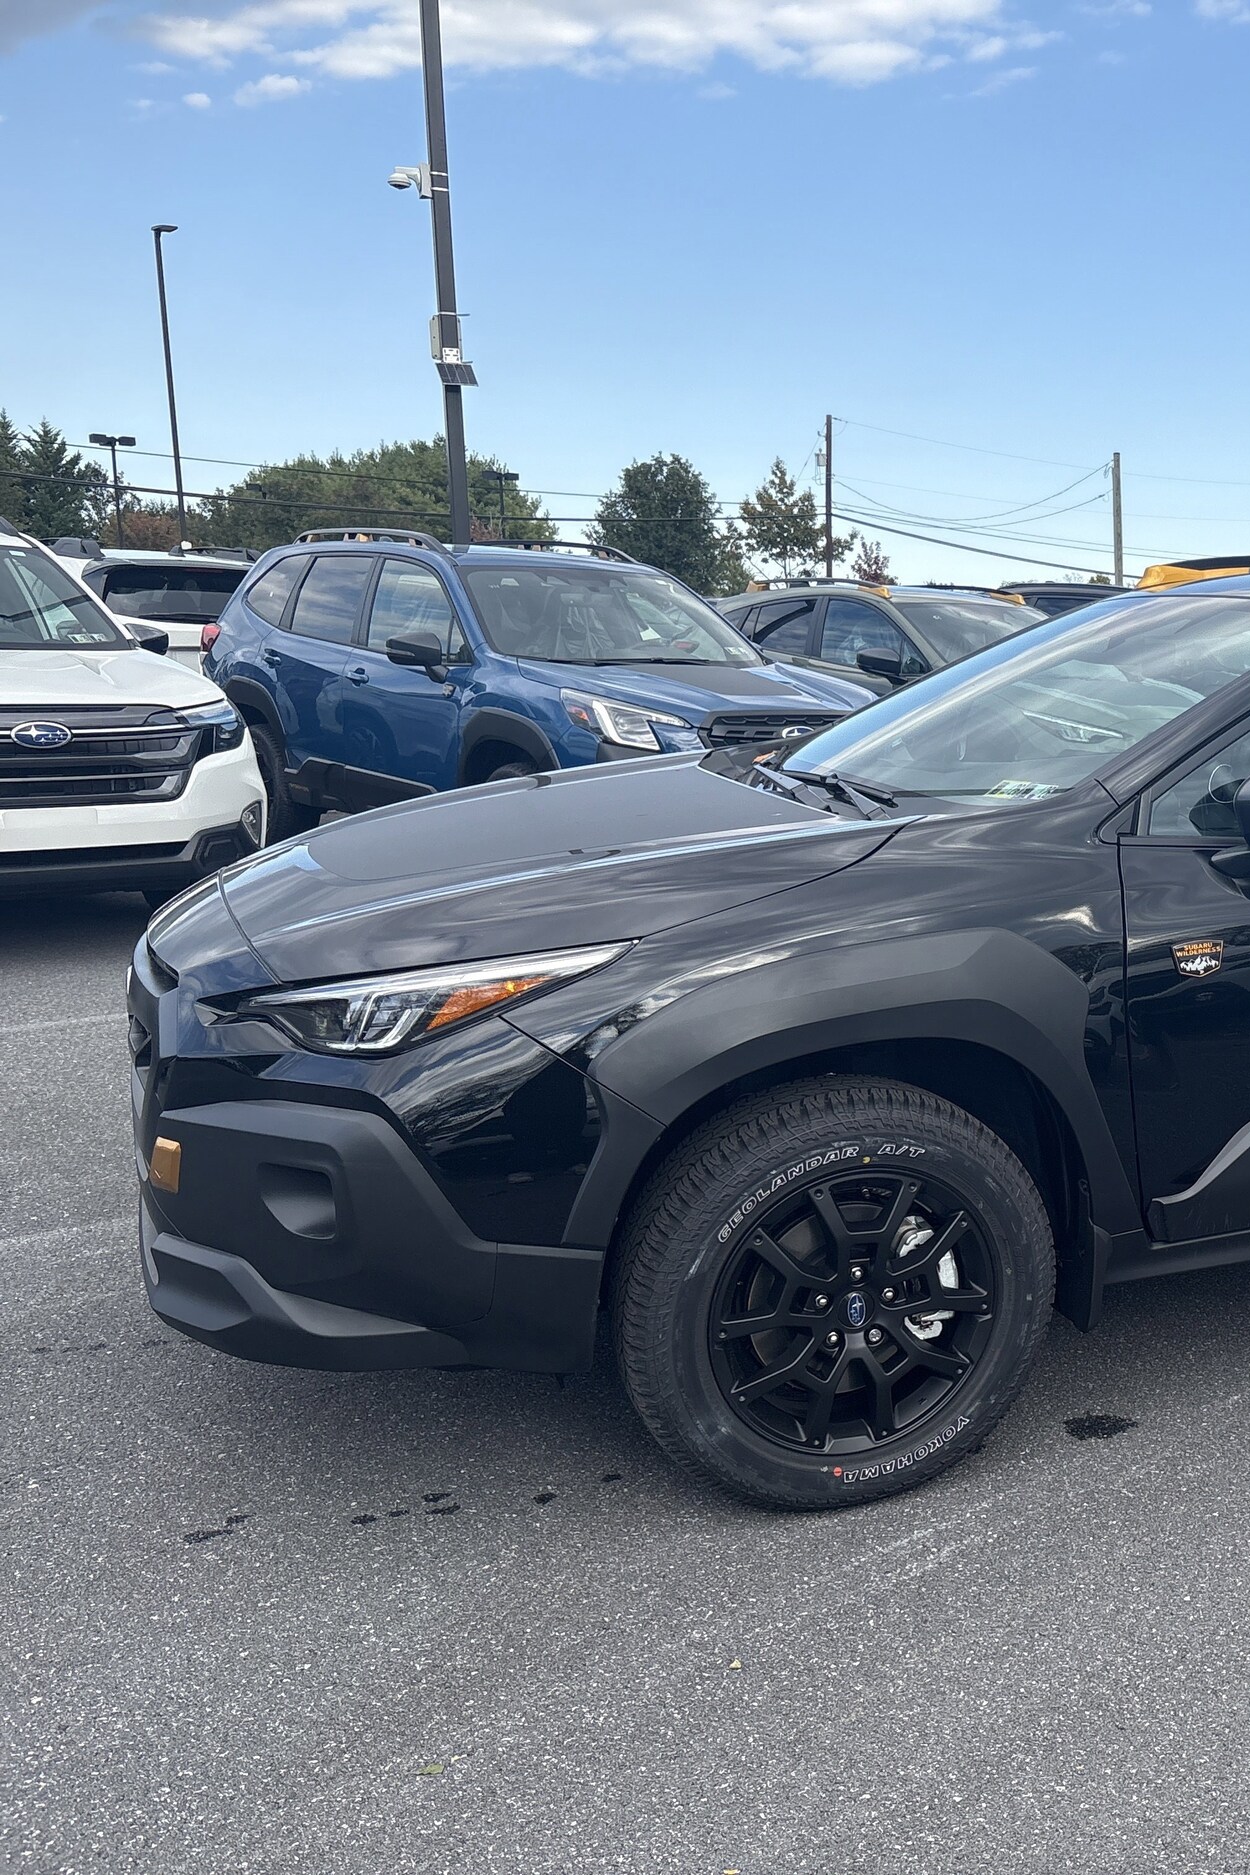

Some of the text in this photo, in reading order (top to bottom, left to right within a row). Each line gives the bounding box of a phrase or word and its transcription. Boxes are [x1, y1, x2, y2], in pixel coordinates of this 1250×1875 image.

[1176, 946, 1221, 957] WILDERNESS
[1184, 942, 1213, 951] SUBARU
[717, 1143, 926, 1243] GEOLANDAR A/T
[843, 1415, 970, 1483] YOKOHAMA
